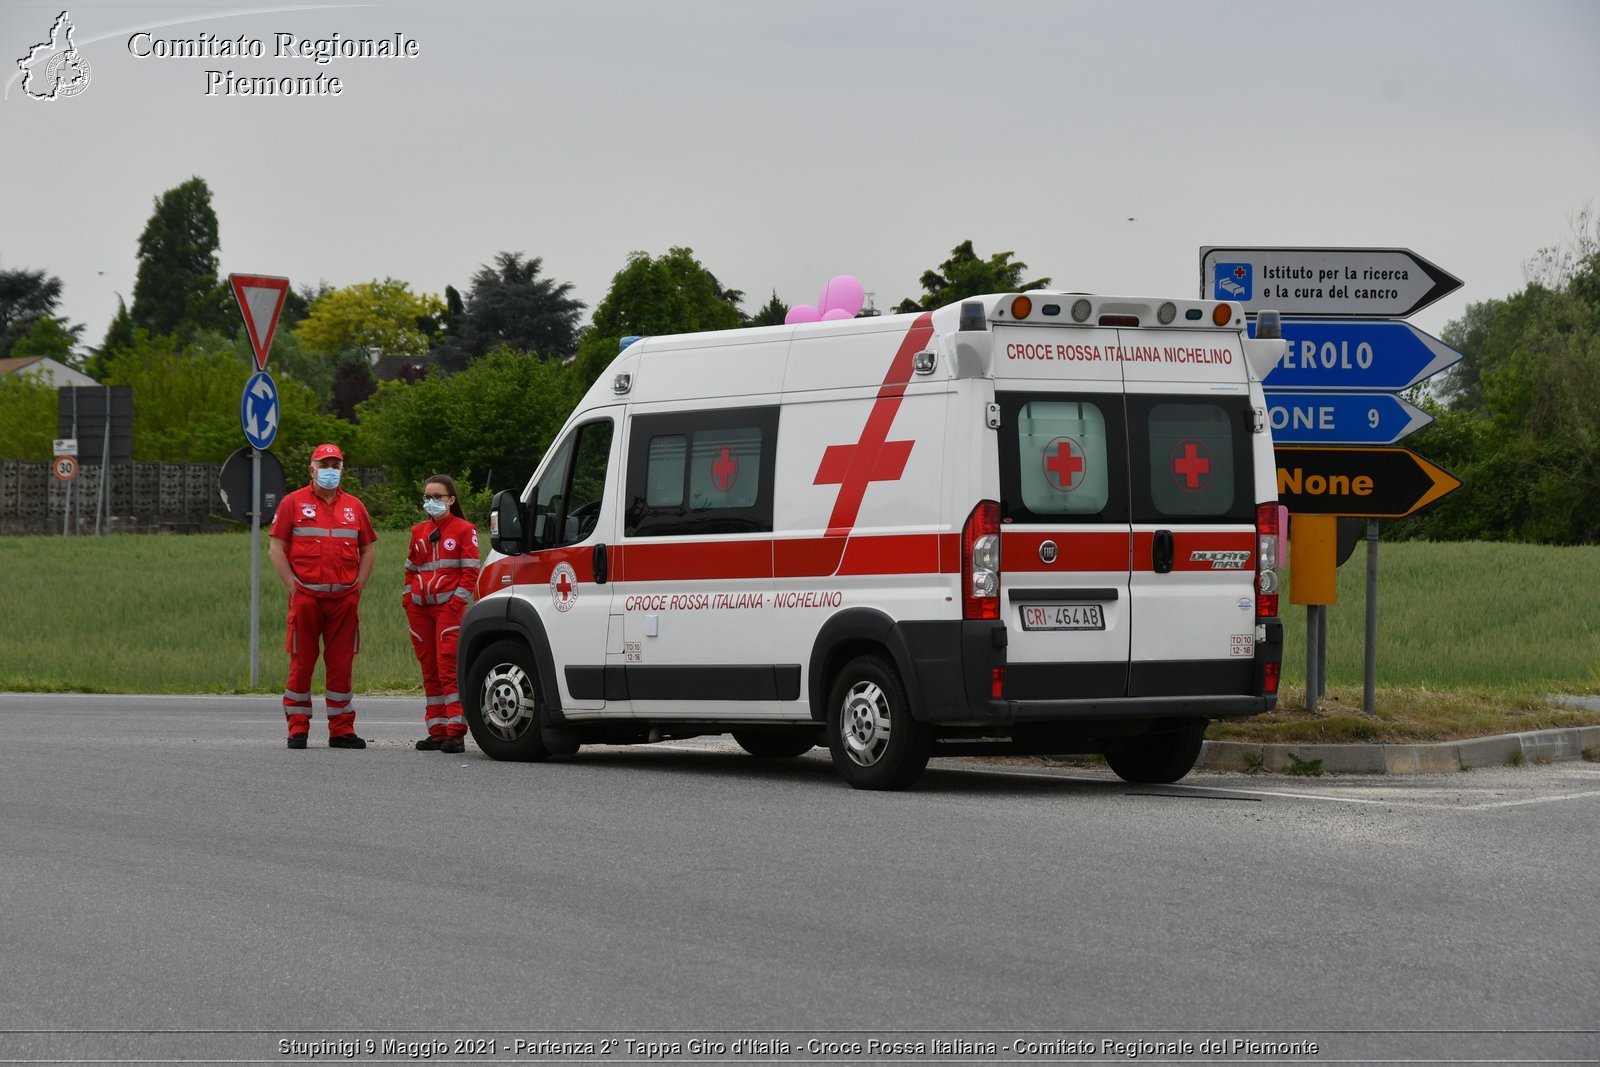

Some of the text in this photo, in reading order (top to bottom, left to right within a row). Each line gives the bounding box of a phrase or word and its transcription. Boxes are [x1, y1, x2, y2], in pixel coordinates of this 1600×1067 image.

[1263, 265, 1409, 283] Istituto per la ricerca
[1263, 284, 1398, 299] e la cura del cancro
[1006, 343, 1233, 365] CROCE ROSSA ITALIANA NICHELINO
[1275, 341, 1374, 369] EROLO
[1367, 408, 1380, 429] 9
[59, 462, 72, 474] 30
[1277, 467, 1374, 496] None
[625, 595, 668, 611] CROCE
[669, 594, 709, 610] ROSSA
[711, 593, 763, 609] ITALIANA
[773, 591, 843, 608] NICHELINO
[1026, 608, 1047, 625] CRI
[626, 643, 633, 651] TO
[1232, 636, 1252, 644] TO 10
